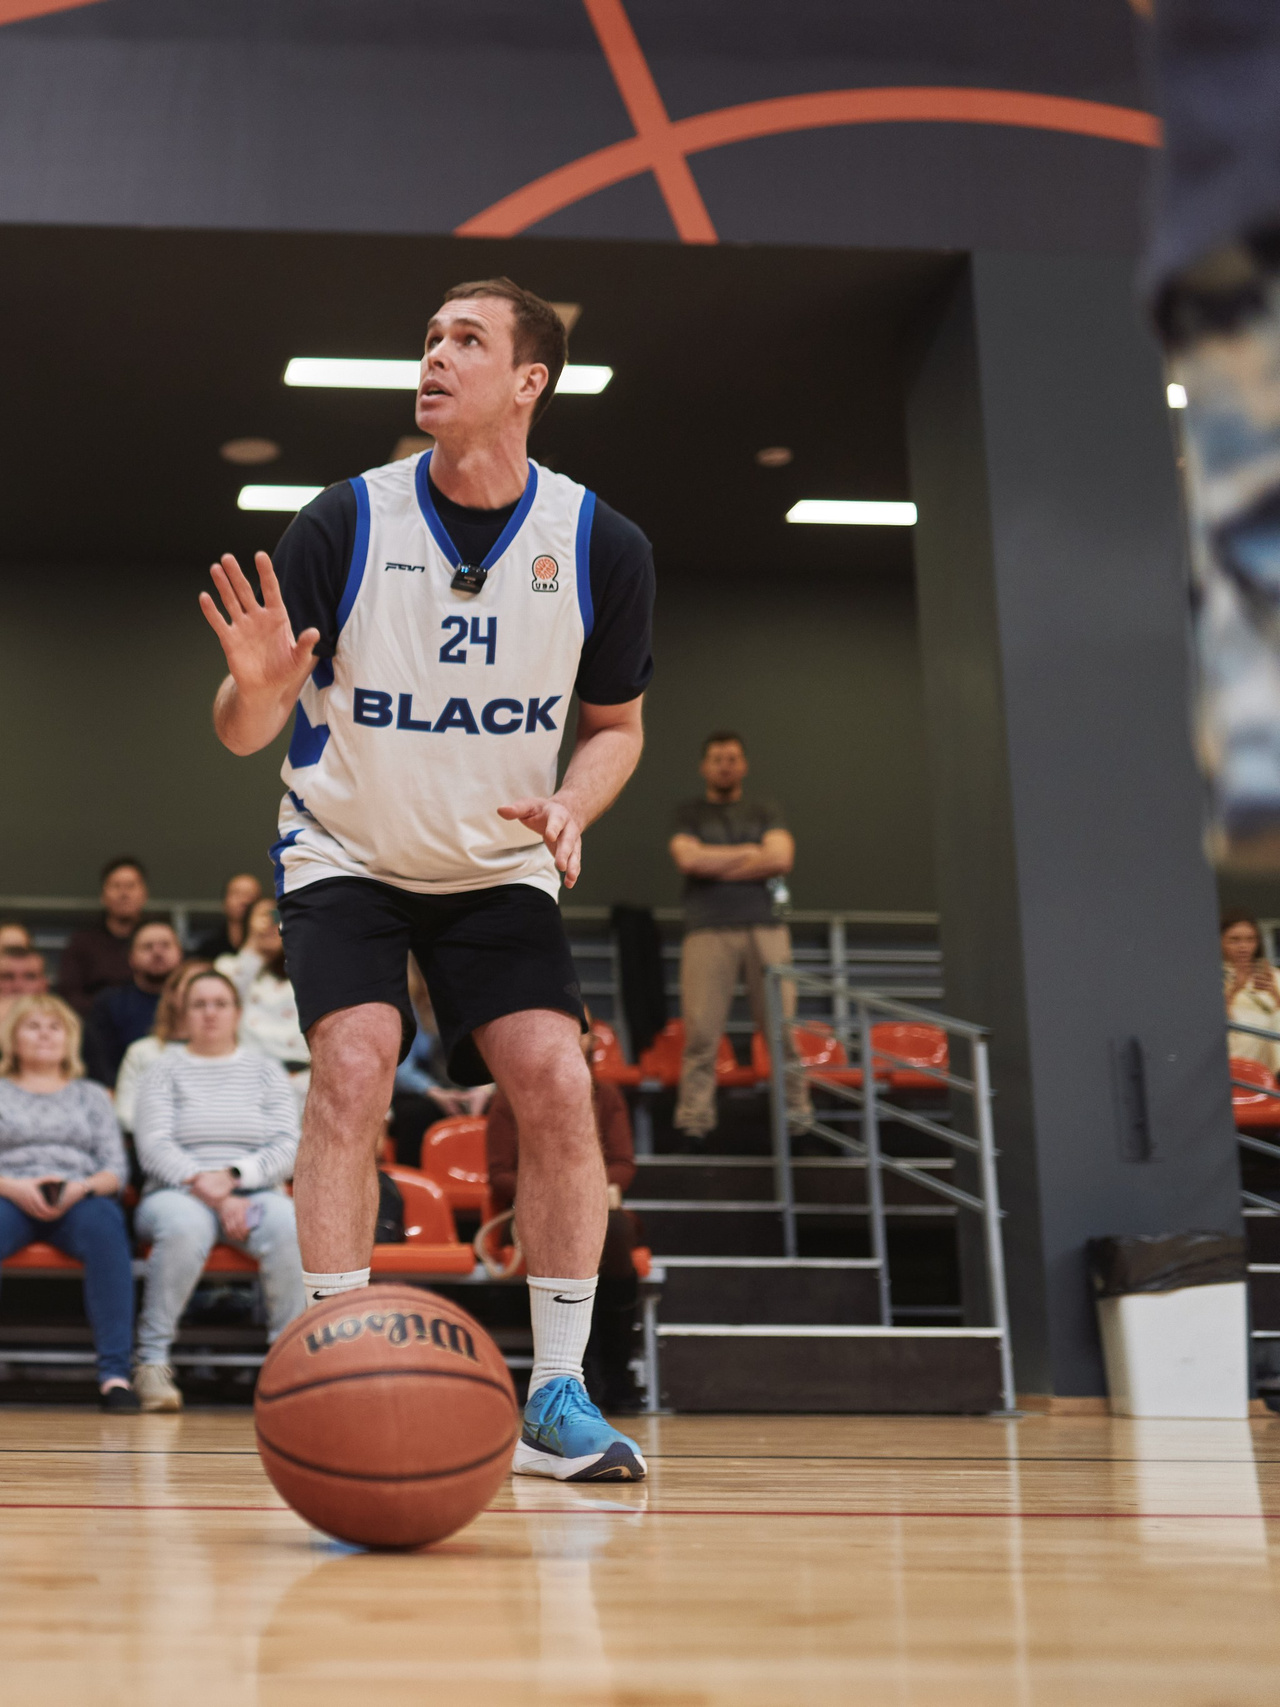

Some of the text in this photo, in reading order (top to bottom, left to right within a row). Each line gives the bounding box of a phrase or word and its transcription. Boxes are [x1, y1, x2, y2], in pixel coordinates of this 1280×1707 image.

[439, 615, 497, 665] 24
[353, 687, 563, 735] BLACK
[302, 1311, 481, 1365] Wilson
